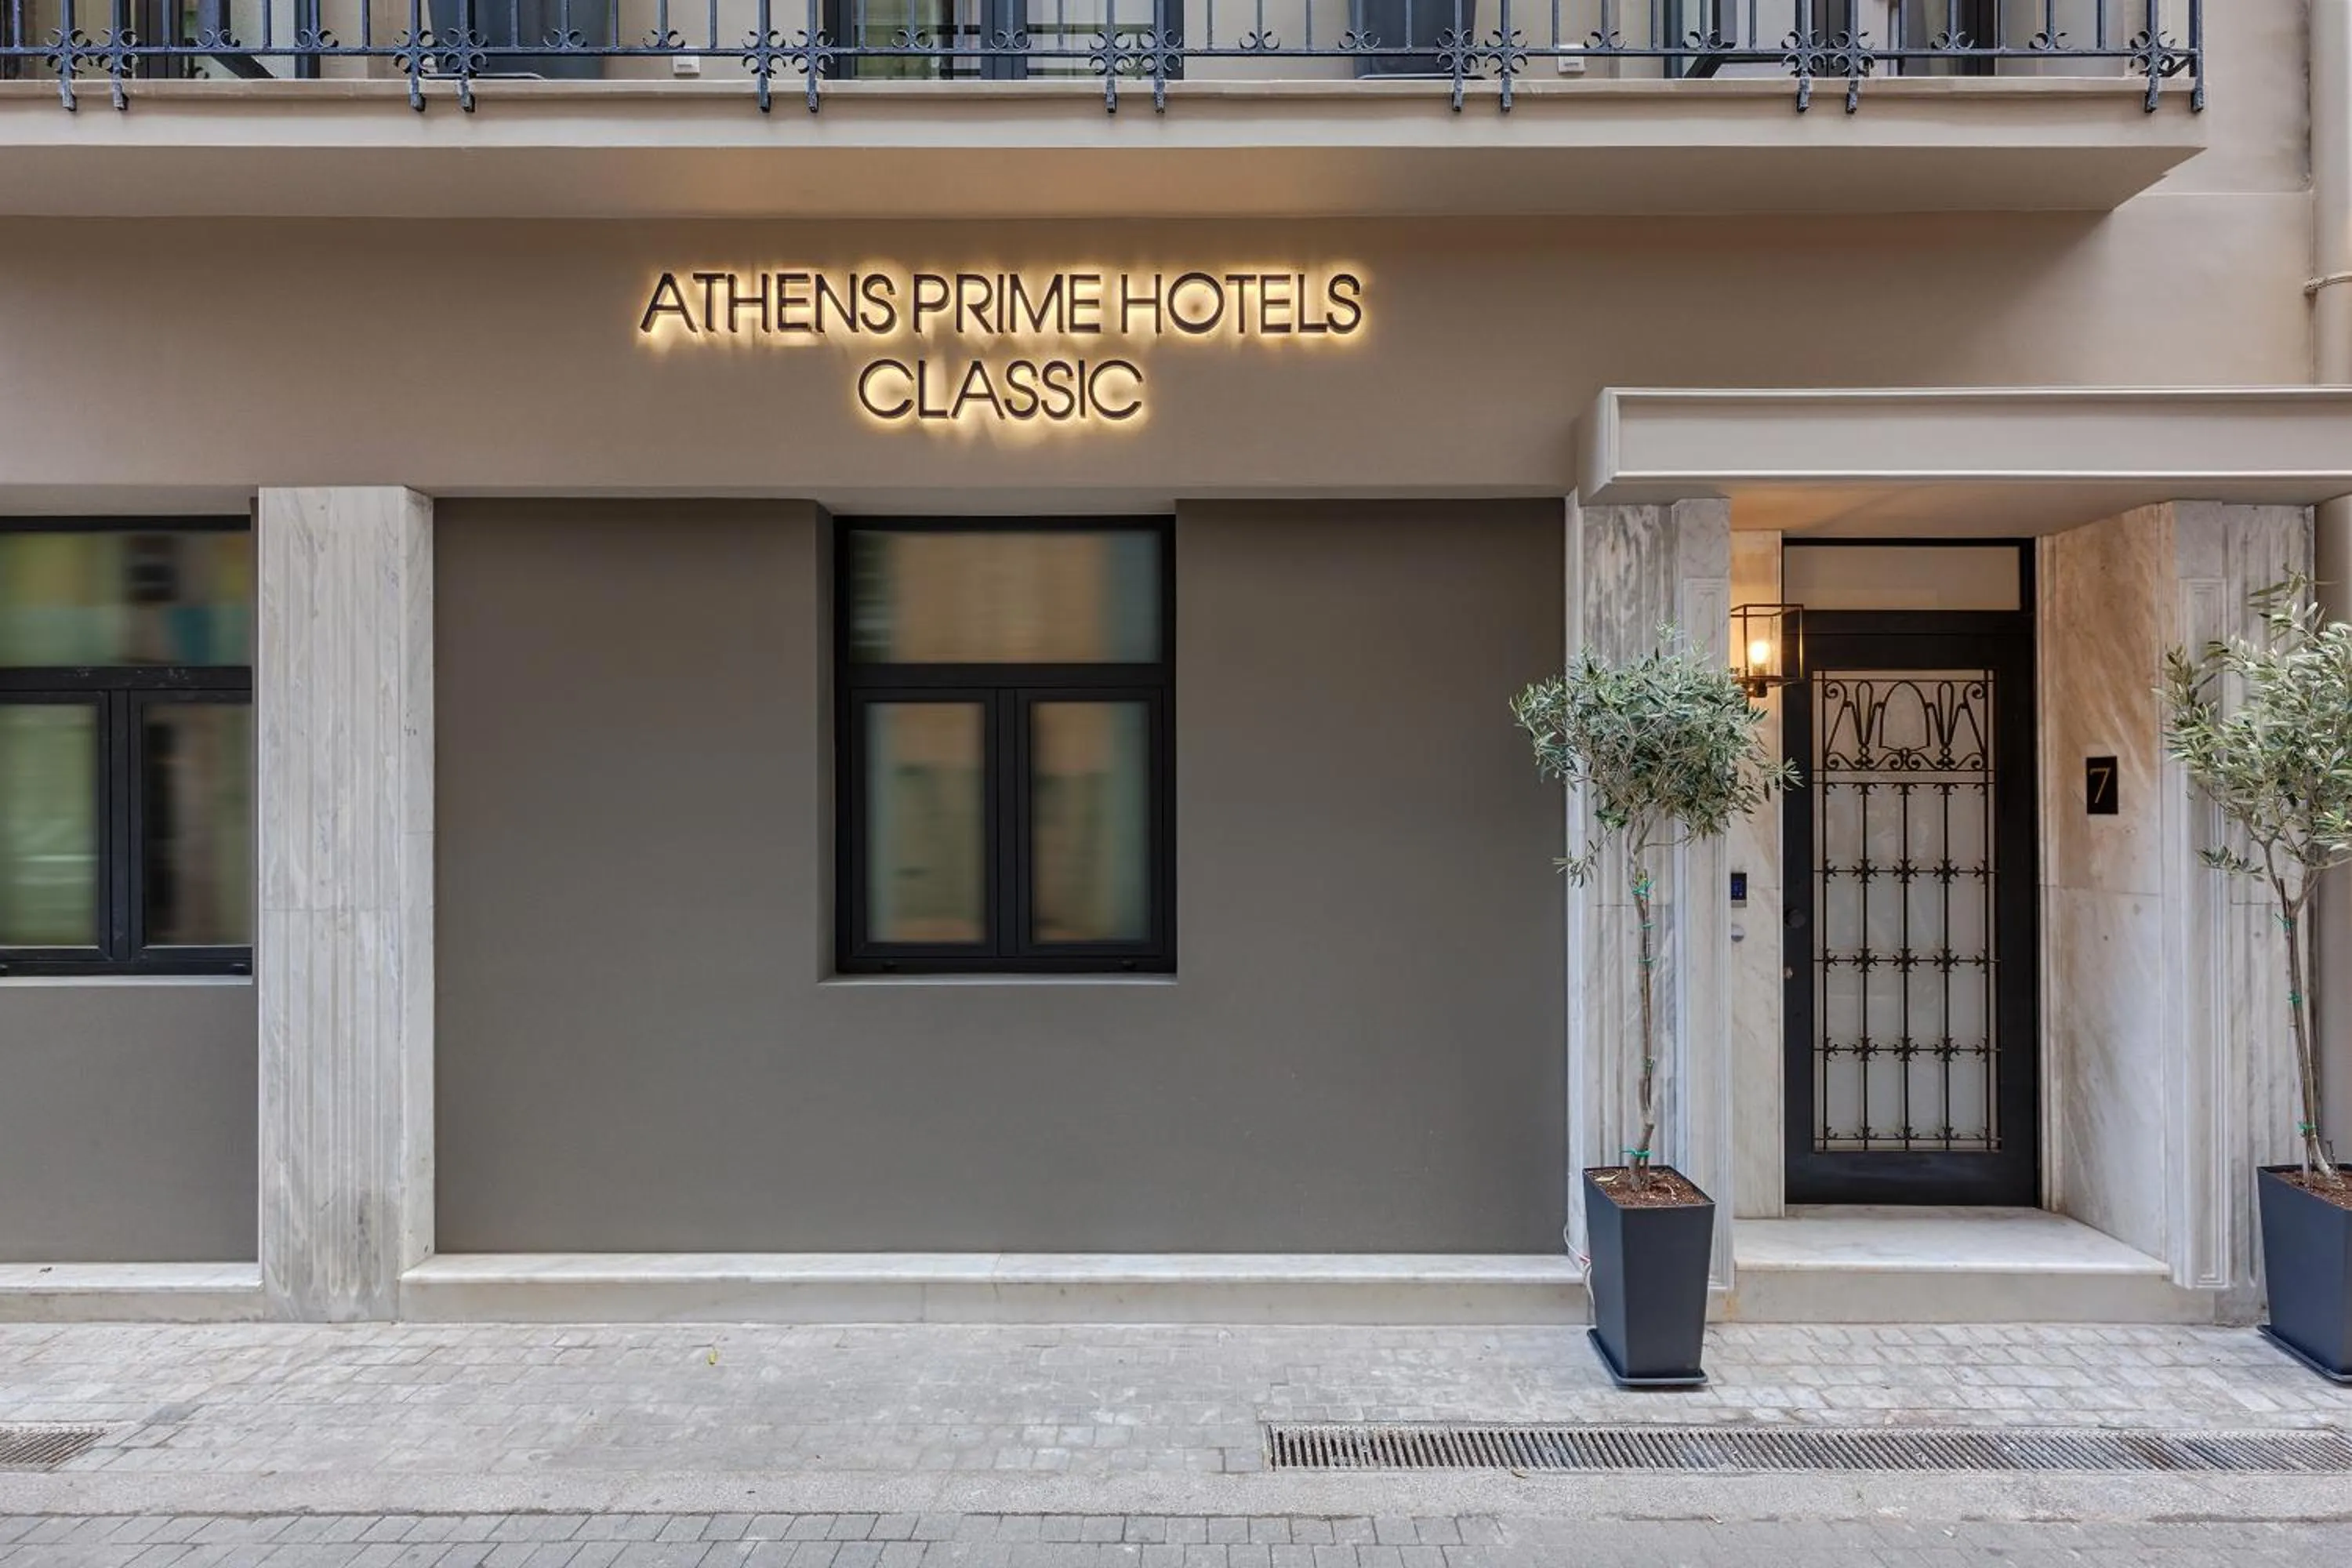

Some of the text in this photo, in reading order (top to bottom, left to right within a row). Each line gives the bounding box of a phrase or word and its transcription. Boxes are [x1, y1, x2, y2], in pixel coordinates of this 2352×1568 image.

[640, 272, 1363, 335] ATHENS PRIME HOTELS
[858, 358, 1144, 420] CLASSIC
[2089, 767, 2111, 804] 7
